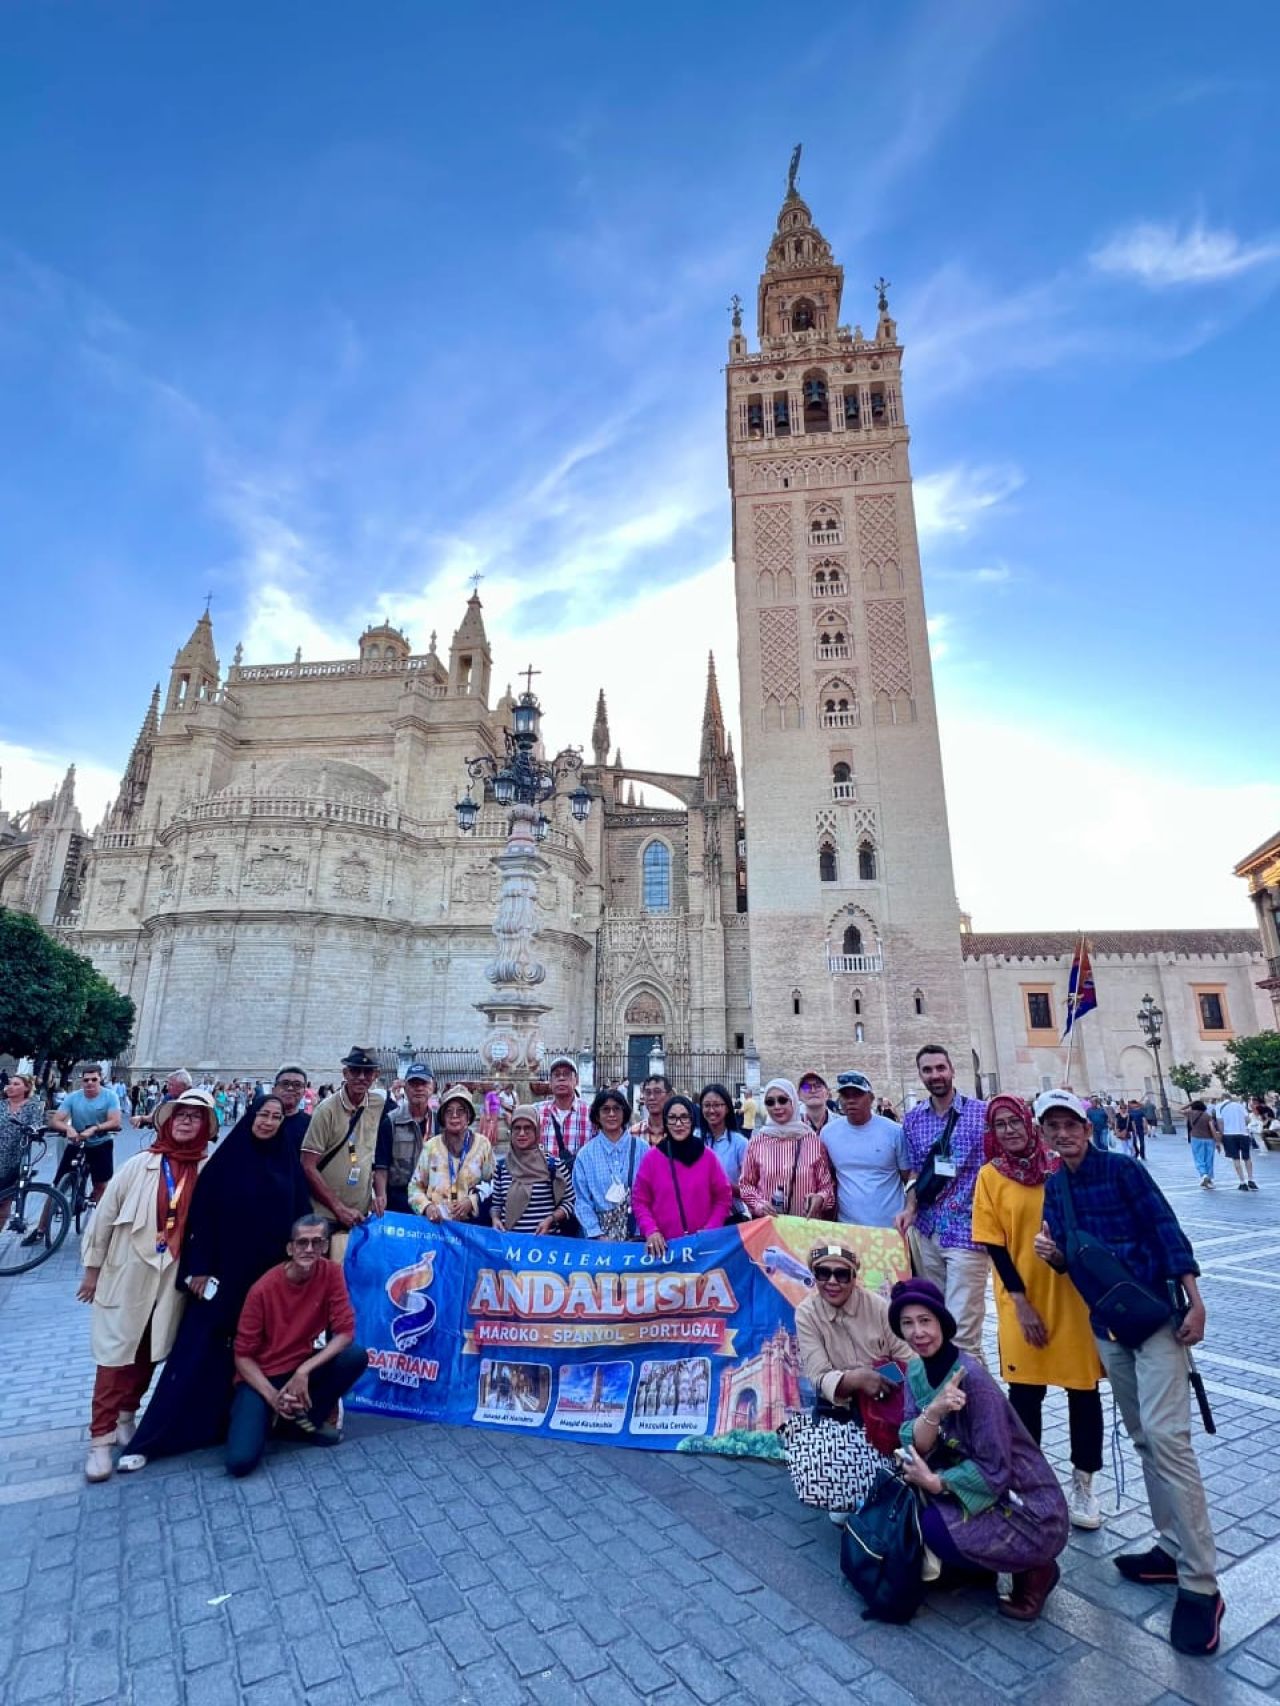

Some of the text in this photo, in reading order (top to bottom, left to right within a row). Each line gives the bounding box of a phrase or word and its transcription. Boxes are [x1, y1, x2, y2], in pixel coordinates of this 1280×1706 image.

[506, 1246, 696, 1267] MOSLEM TOUR
[469, 1268, 739, 1317] ANDALUSIA
[478, 1325, 540, 1342] MAROKO
[552, 1328, 625, 1343] SPANYOL
[639, 1322, 719, 1338] PORTUGAL
[366, 1347, 440, 1382] SATRIANI
